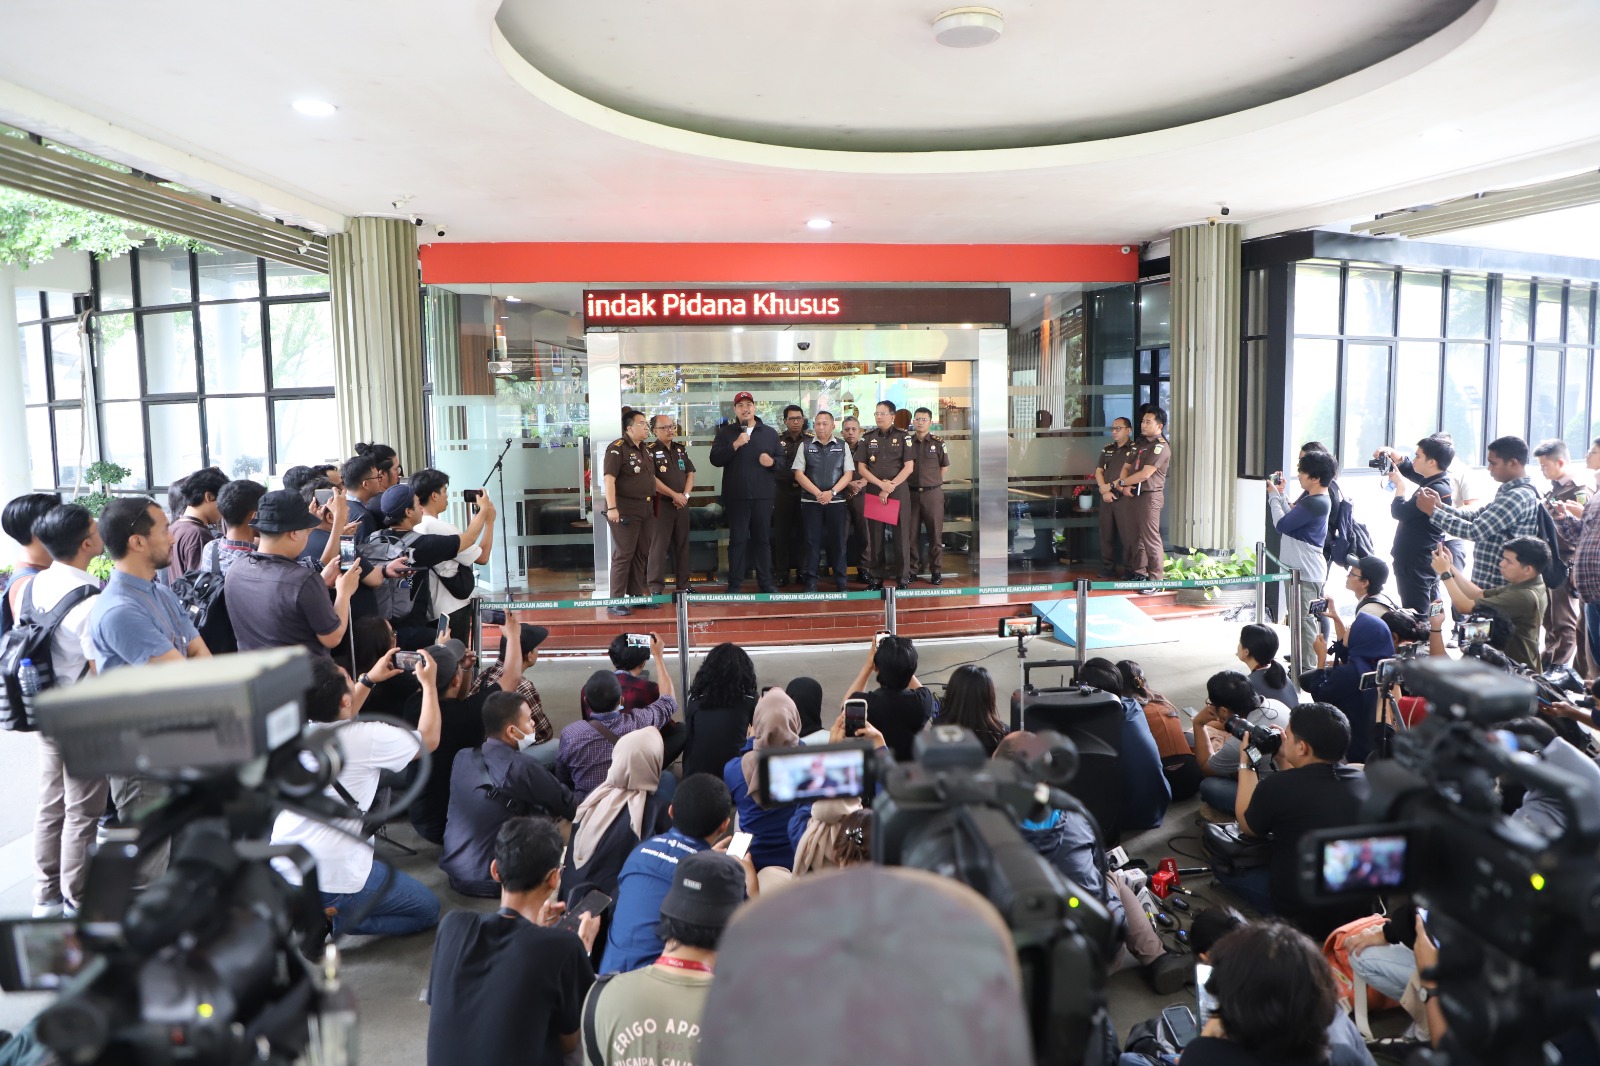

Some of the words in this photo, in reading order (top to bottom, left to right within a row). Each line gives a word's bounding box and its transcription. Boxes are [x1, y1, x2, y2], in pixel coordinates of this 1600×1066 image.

[588, 293, 656, 316] indak
[662, 293, 746, 316] Pidana
[753, 293, 840, 315] Khusus
[574, 599, 602, 607] PUSPENKUM
[603, 598, 629, 606] KEJAKSAAN
[612, 1018, 657, 1056] ERIGO
[665, 1018, 703, 1043] APP
